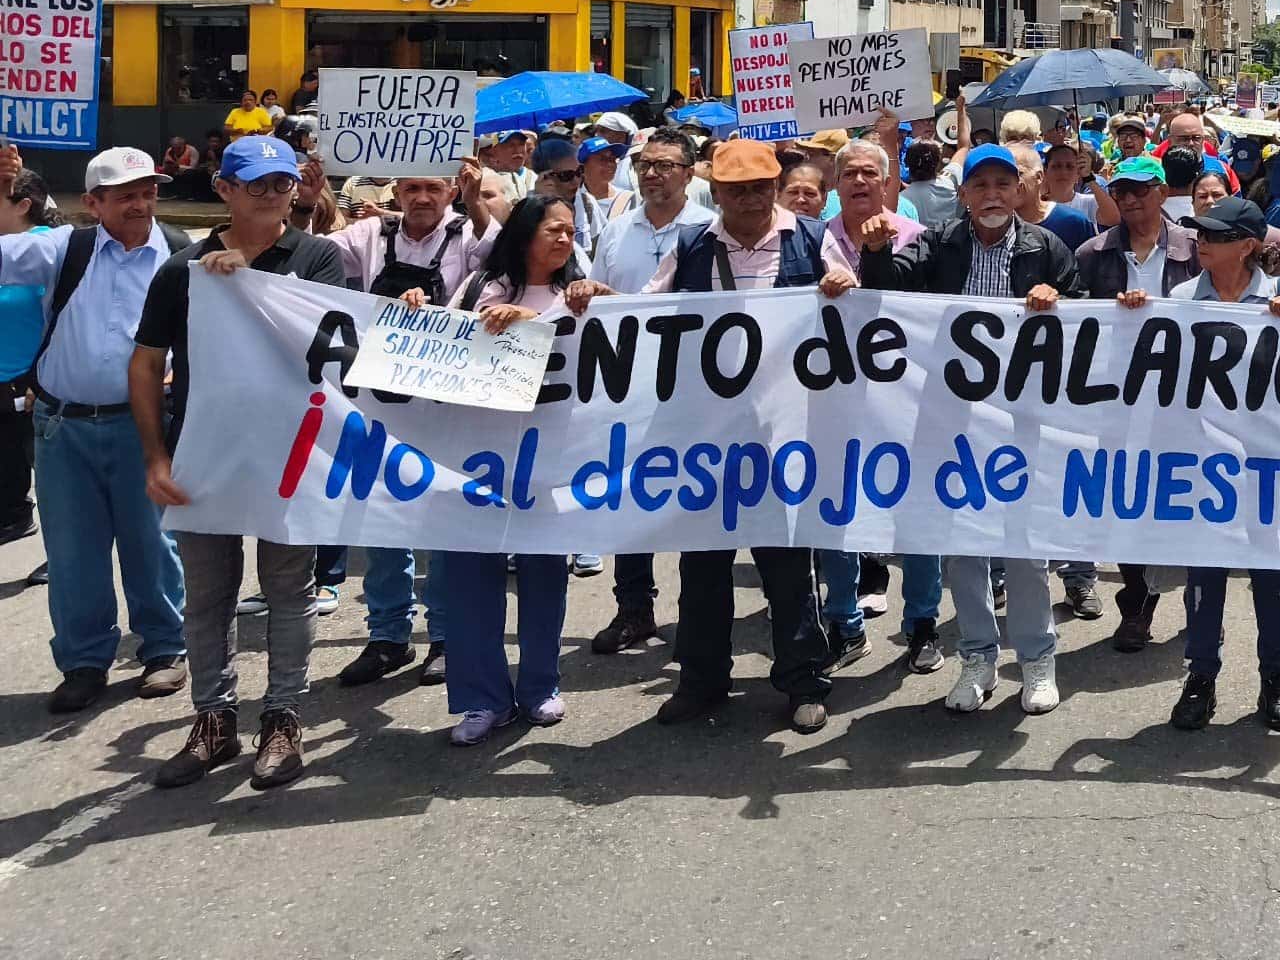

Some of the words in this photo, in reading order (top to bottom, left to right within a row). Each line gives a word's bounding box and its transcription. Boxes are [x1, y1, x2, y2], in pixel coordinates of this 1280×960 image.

[52, 15, 95, 39] DEL
[749, 34, 769, 49] NO
[40, 42, 72, 64] SE
[828, 39, 851, 57] NO
[861, 34, 900, 52] MAS
[798, 50, 906, 82] PENSIONES
[357, 74, 460, 111] FUERA
[851, 77, 871, 92] DE
[819, 89, 906, 118] HAMBRE
[320, 114, 331, 130] EL
[336, 111, 465, 129] INSTRUCTIVO
[260, 142, 278, 158] LA
[333, 128, 470, 164] ONAPRE
[376, 302, 451, 334] AUMENTO
[453, 315, 479, 341] DE
[383, 332, 470, 370] SALARIOS
[793, 305, 908, 390] de
[462, 427, 538, 511] al
[934, 433, 1029, 511] de
